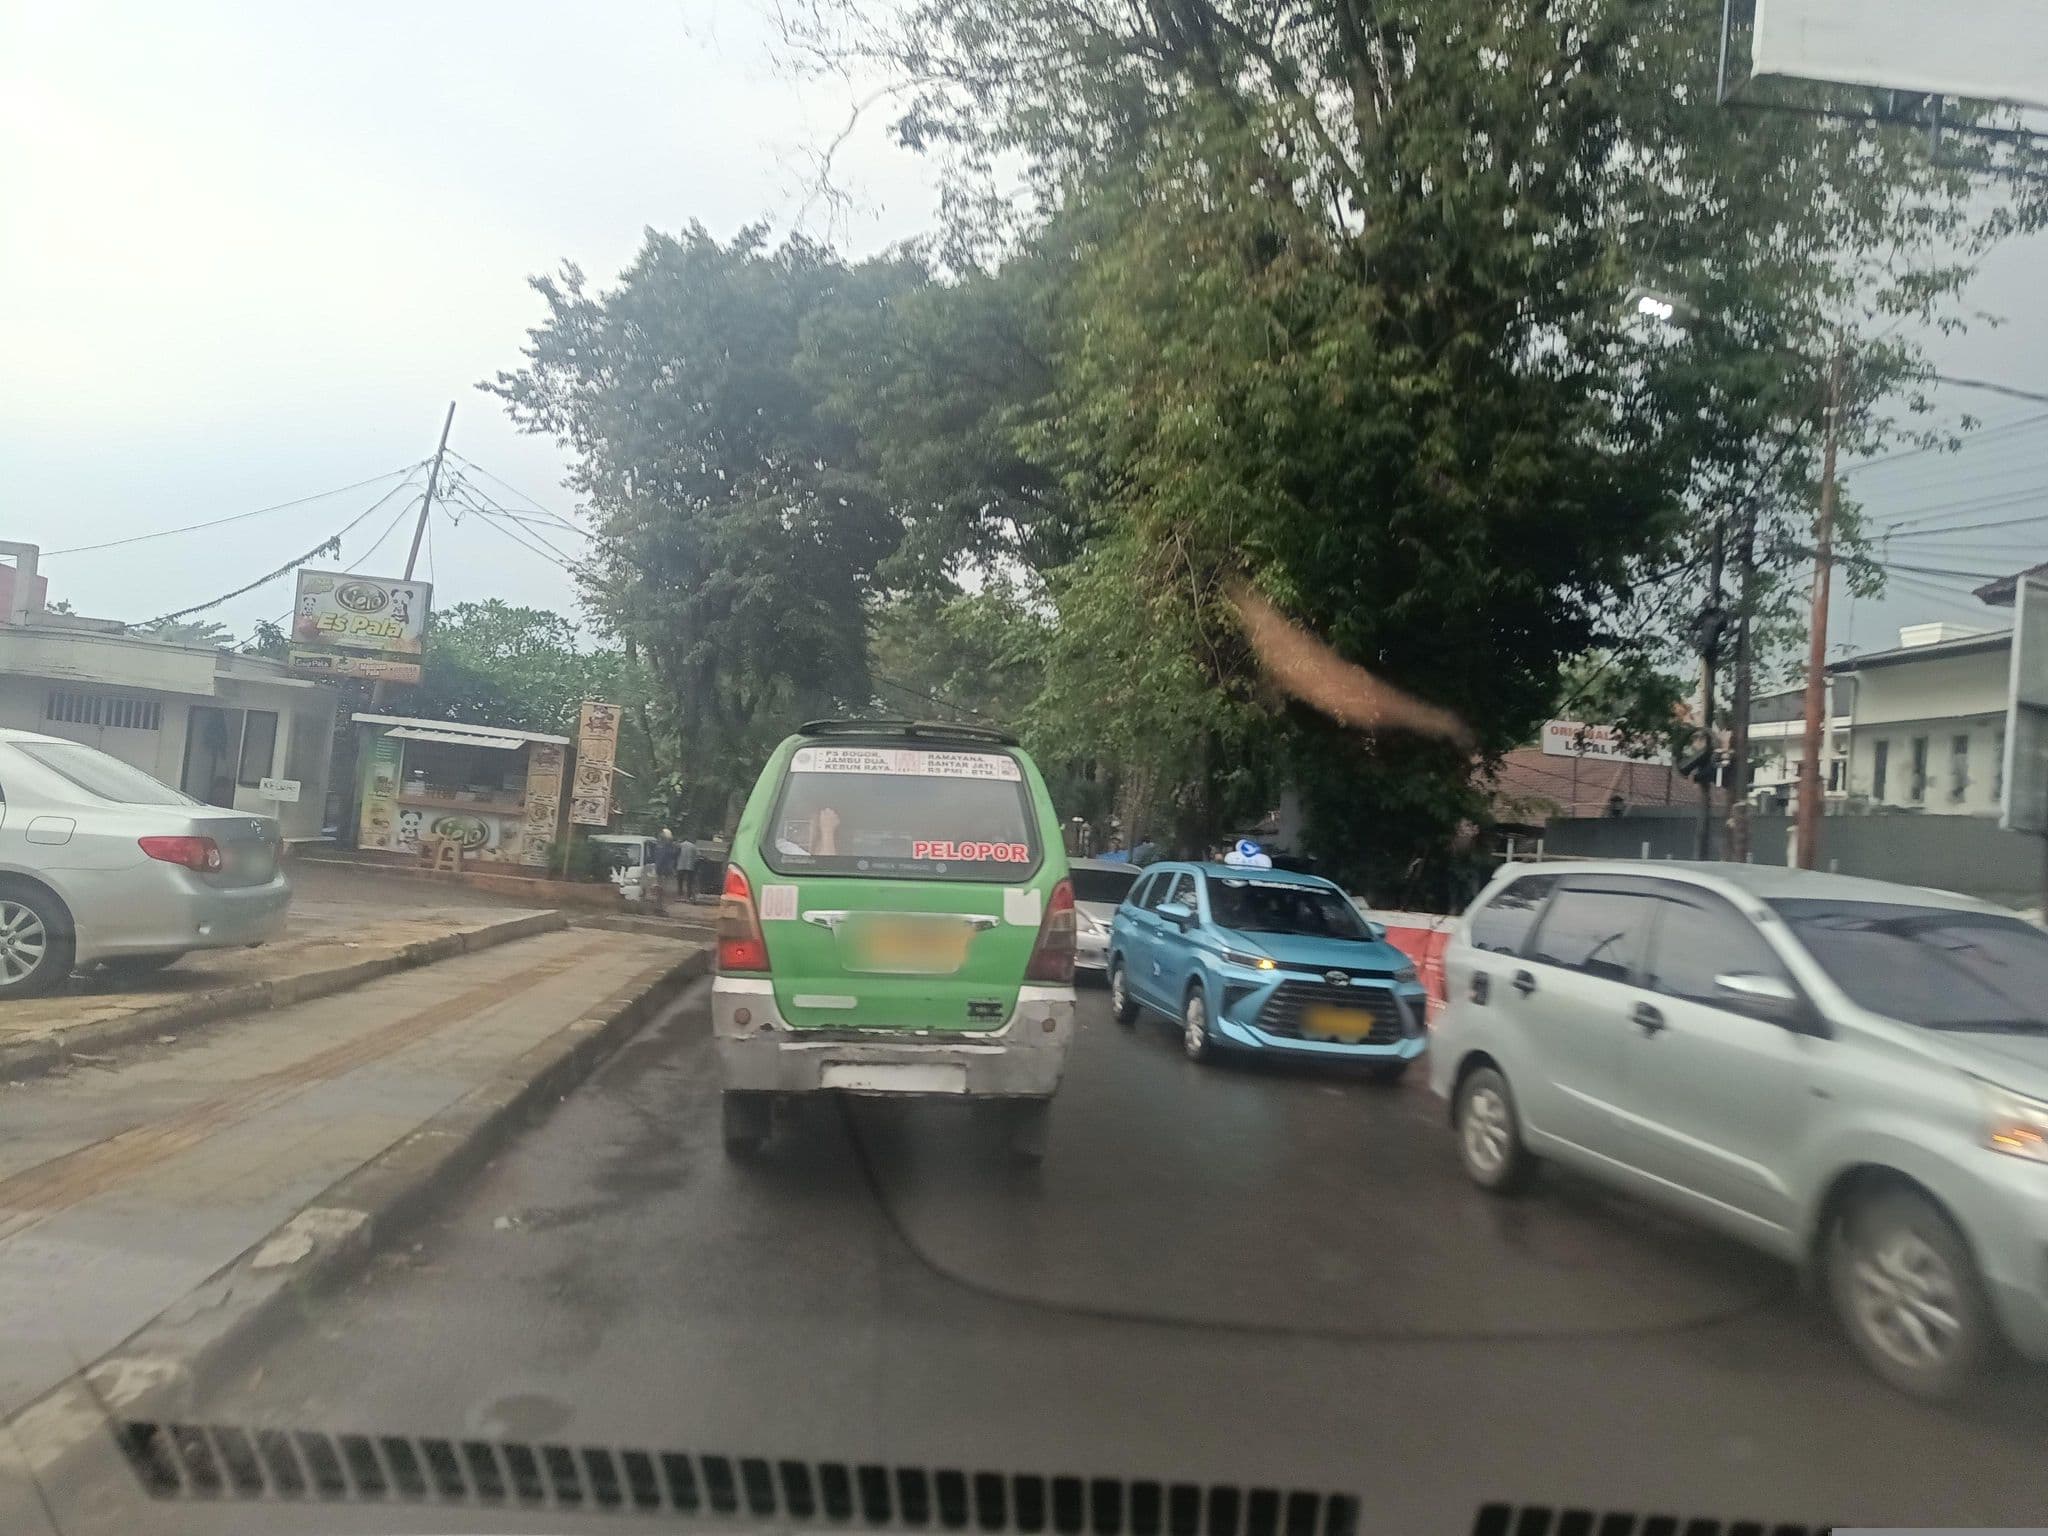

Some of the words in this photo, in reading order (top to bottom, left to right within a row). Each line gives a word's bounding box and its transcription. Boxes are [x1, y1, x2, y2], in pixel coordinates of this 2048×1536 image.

[316, 612, 348, 632] Es
[349, 614, 403, 638] Pala
[1565, 740, 1608, 754] LOCAL
[913, 841, 1030, 863] PELOPOR
